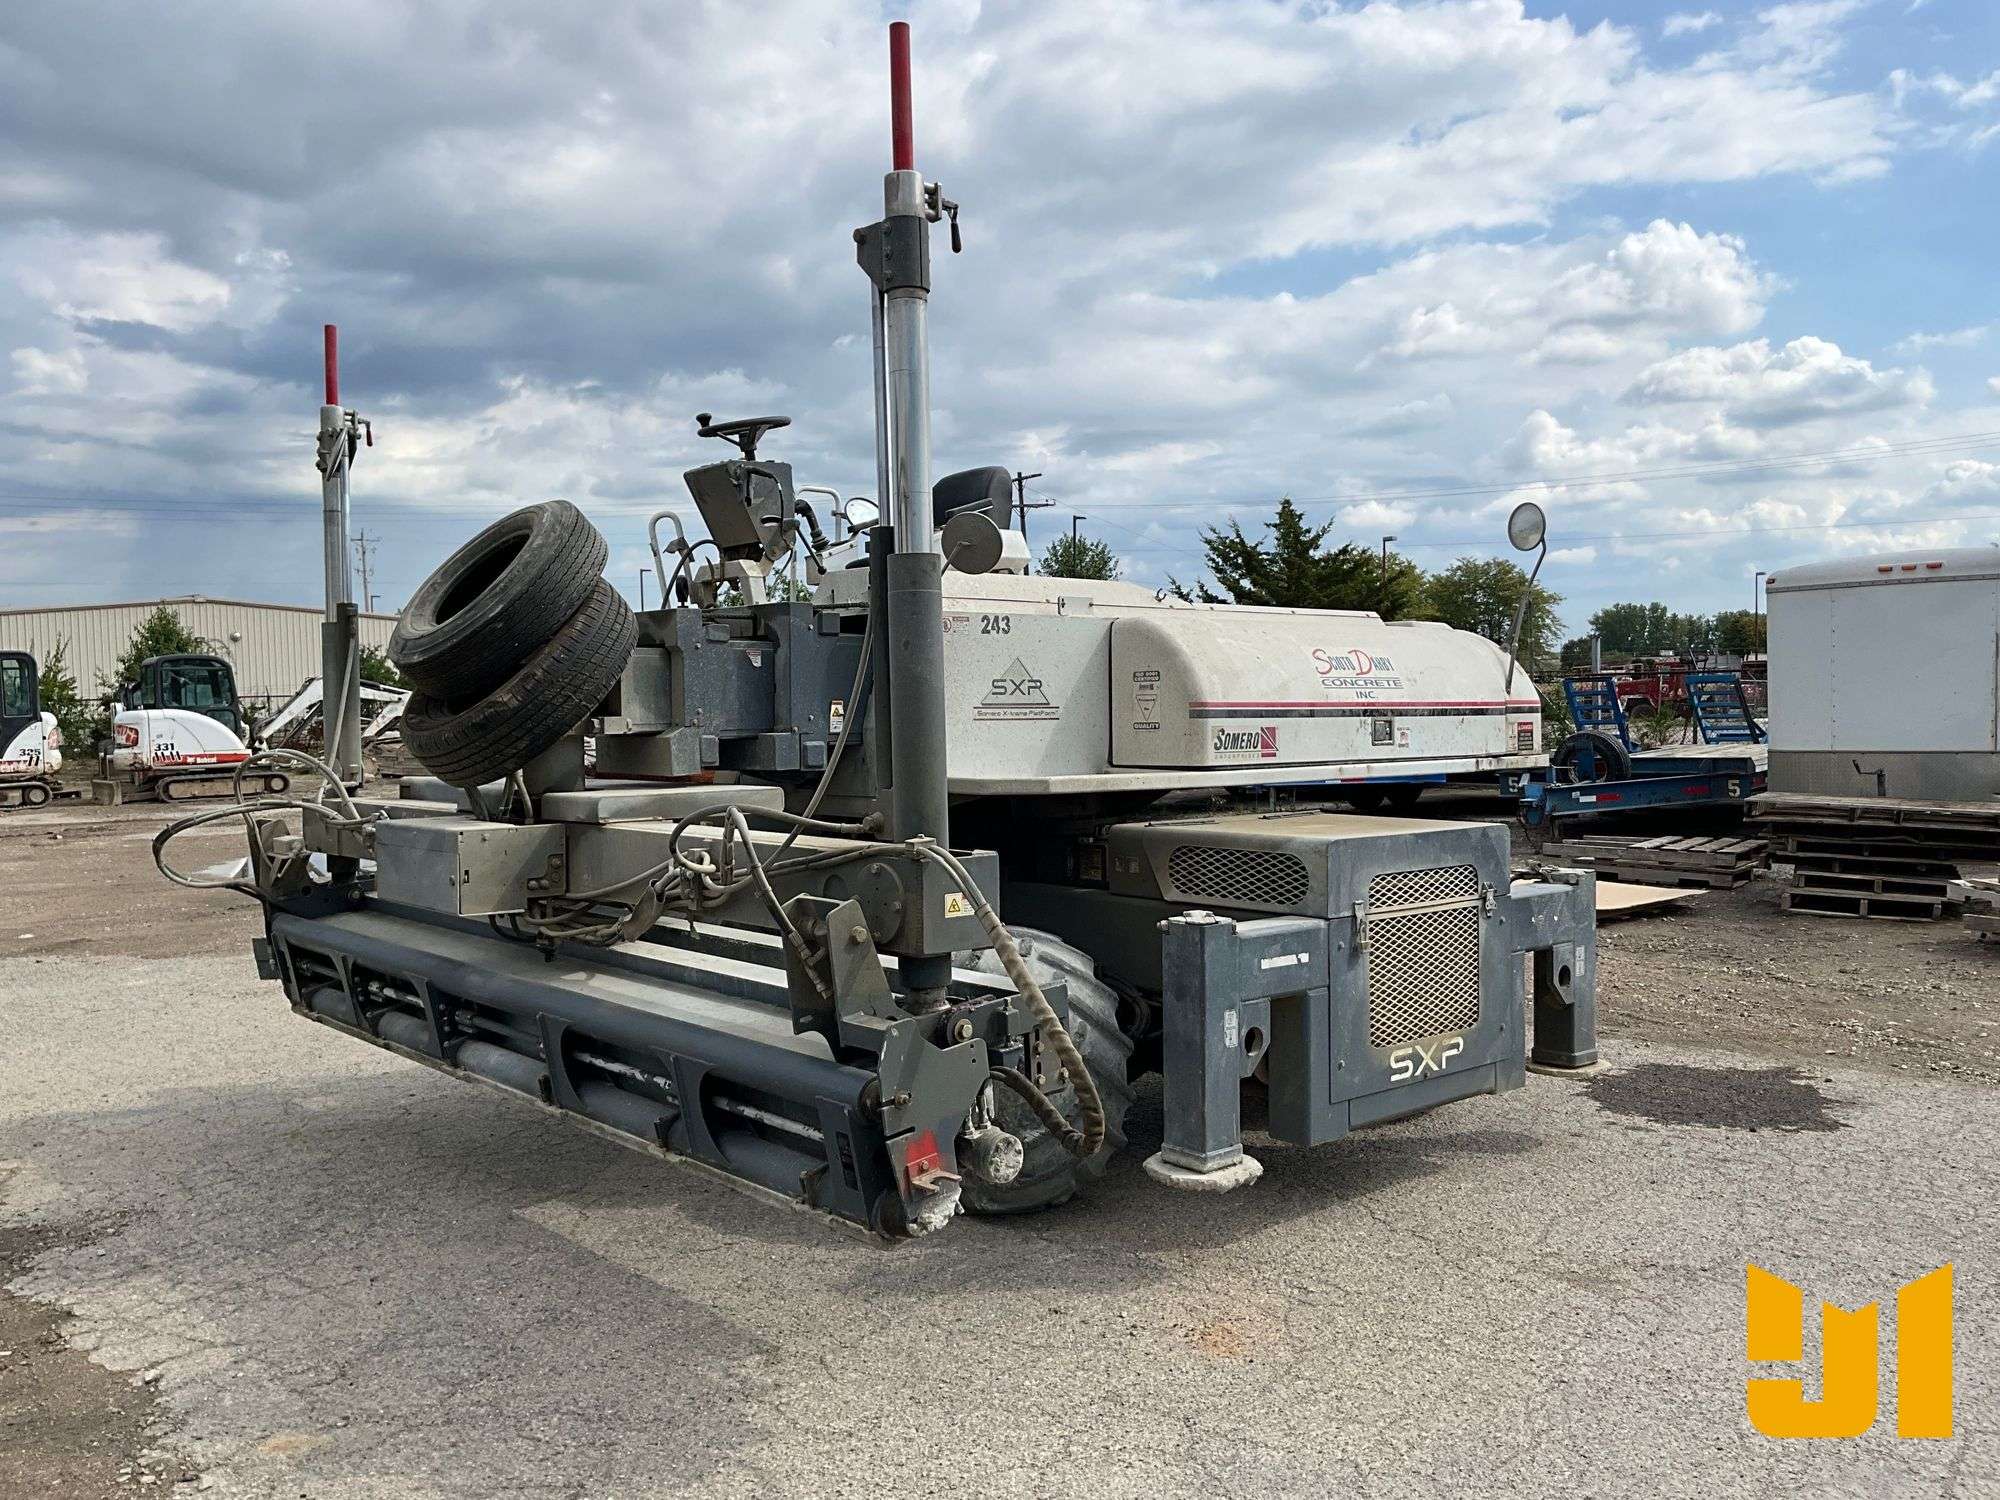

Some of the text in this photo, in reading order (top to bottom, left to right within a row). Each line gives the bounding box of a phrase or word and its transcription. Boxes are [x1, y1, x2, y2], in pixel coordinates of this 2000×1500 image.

[980, 614, 1011, 635] 243
[991, 679, 1043, 696] SXP
[1321, 678, 1404, 687] CONCRETE
[1355, 690, 1379, 699] INC.
[154, 742, 175, 752] 331
[1214, 727, 1260, 751] SOMERO
[19, 748, 42, 757] 325
[1508, 776, 1519, 793] 5
[1727, 779, 1741, 799] 5
[1390, 1036, 1464, 1082] SXP
